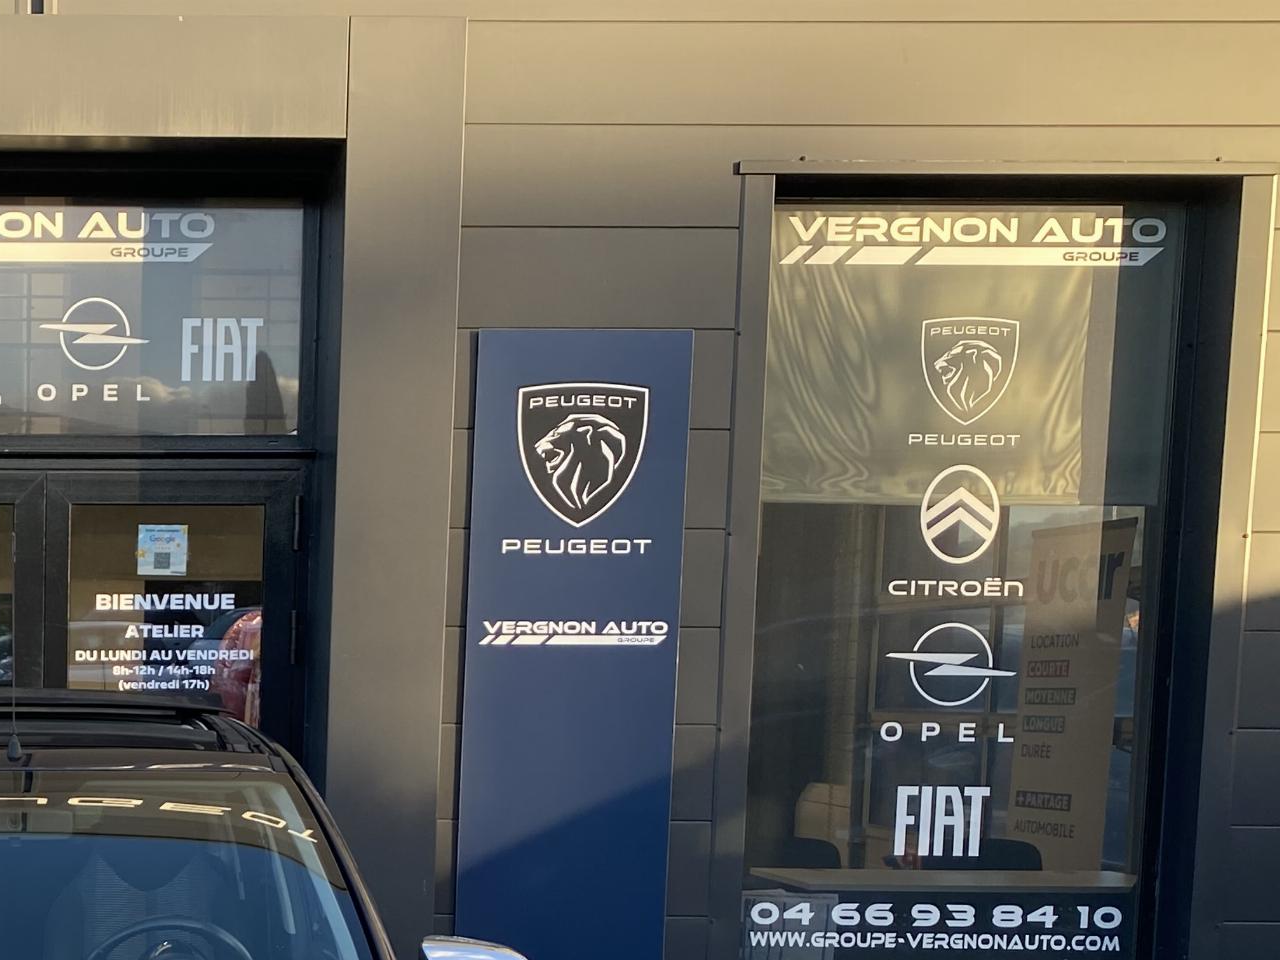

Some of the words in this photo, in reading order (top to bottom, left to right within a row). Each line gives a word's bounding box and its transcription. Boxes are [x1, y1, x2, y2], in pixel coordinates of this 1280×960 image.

[78, 211, 216, 239] AUTO
[788, 216, 1020, 243] VERGNON
[1031, 217, 1167, 244] AUTO
[109, 246, 190, 259] GROUPE
[1062, 251, 1141, 262] GROUPE
[930, 325, 1012, 338] PEUGEOT
[180, 317, 265, 382] FIAT
[37, 383, 151, 402] OPEL
[529, 394, 638, 409] PEUGEOT
[907, 433, 1022, 447] PEUGEOT
[501, 539, 652, 554] PEUGEOT
[95, 593, 235, 610] BIENVENUE
[124, 624, 204, 638] ATELIER
[482, 620, 597, 634] VERGNON
[601, 620, 668, 634] AUTO
[1031, 633, 1080, 649] LOCATION
[75, 649, 97, 661] DU
[100, 649, 146, 661] LUNDI
[150, 649, 171, 661] AU
[175, 649, 254, 660] VENDREDI
[112, 665, 155, 675] 8h-12h
[169, 665, 216, 675] 14h-18h
[118, 679, 179, 691] (vendredi
[182, 679, 210, 691] 17h)
[880, 722, 1014, 743] OPEL
[893, 785, 991, 857] FIAT
[1014, 818, 1076, 839] AUTOMOBILE
[750, 902, 816, 926] 04
[831, 902, 895, 927] 66
[910, 903, 976, 928] 93
[991, 904, 1059, 929] 84
[1076, 905, 1122, 929] 10
[749, 930, 1121, 952] WWW.GROUPE-VERGNONAUTO.COM
